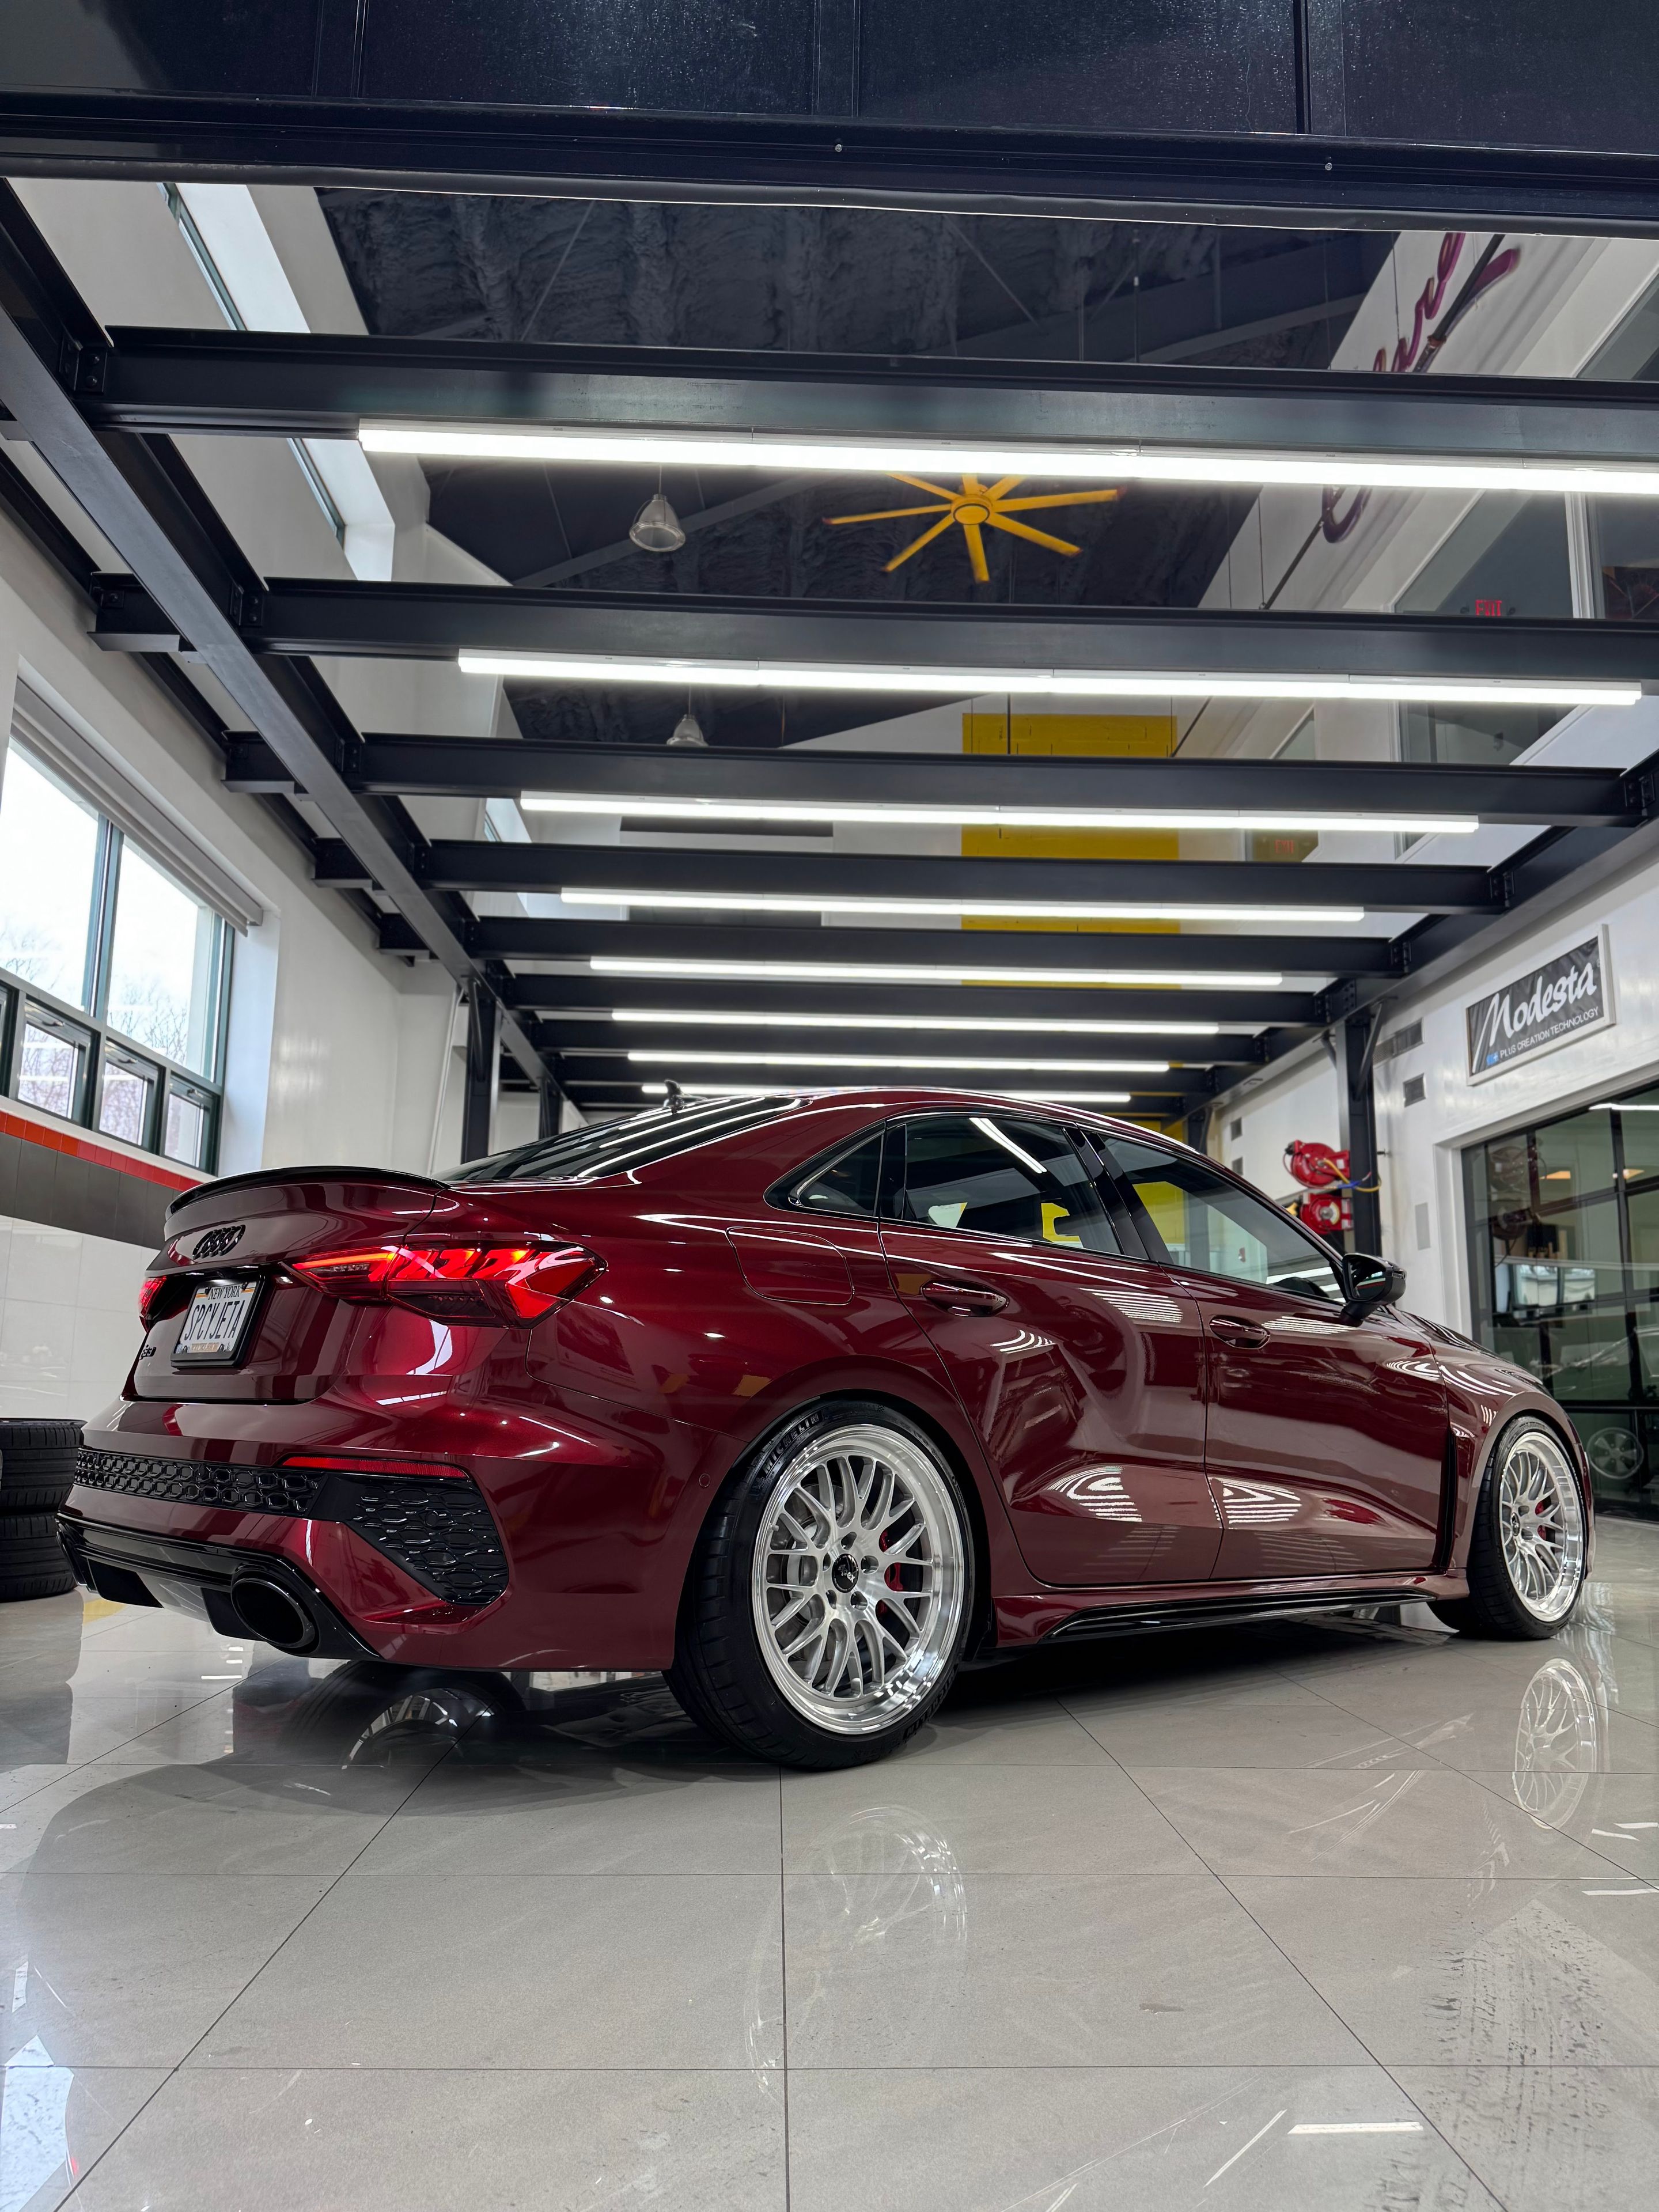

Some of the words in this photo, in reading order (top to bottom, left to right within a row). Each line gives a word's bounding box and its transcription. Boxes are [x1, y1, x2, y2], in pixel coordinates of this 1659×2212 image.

[1472, 963, 1597, 1073] Modesta
[1500, 1045, 1516, 1059] PLUS
[1517, 1029, 1550, 1051] CREATION
[1550, 1006, 1599, 1035] TECHNOLOGY
[208, 1287, 224, 1300] NEW
[224, 1285, 241, 1299] YORK
[763, 1412, 820, 1475] MICHELIN
